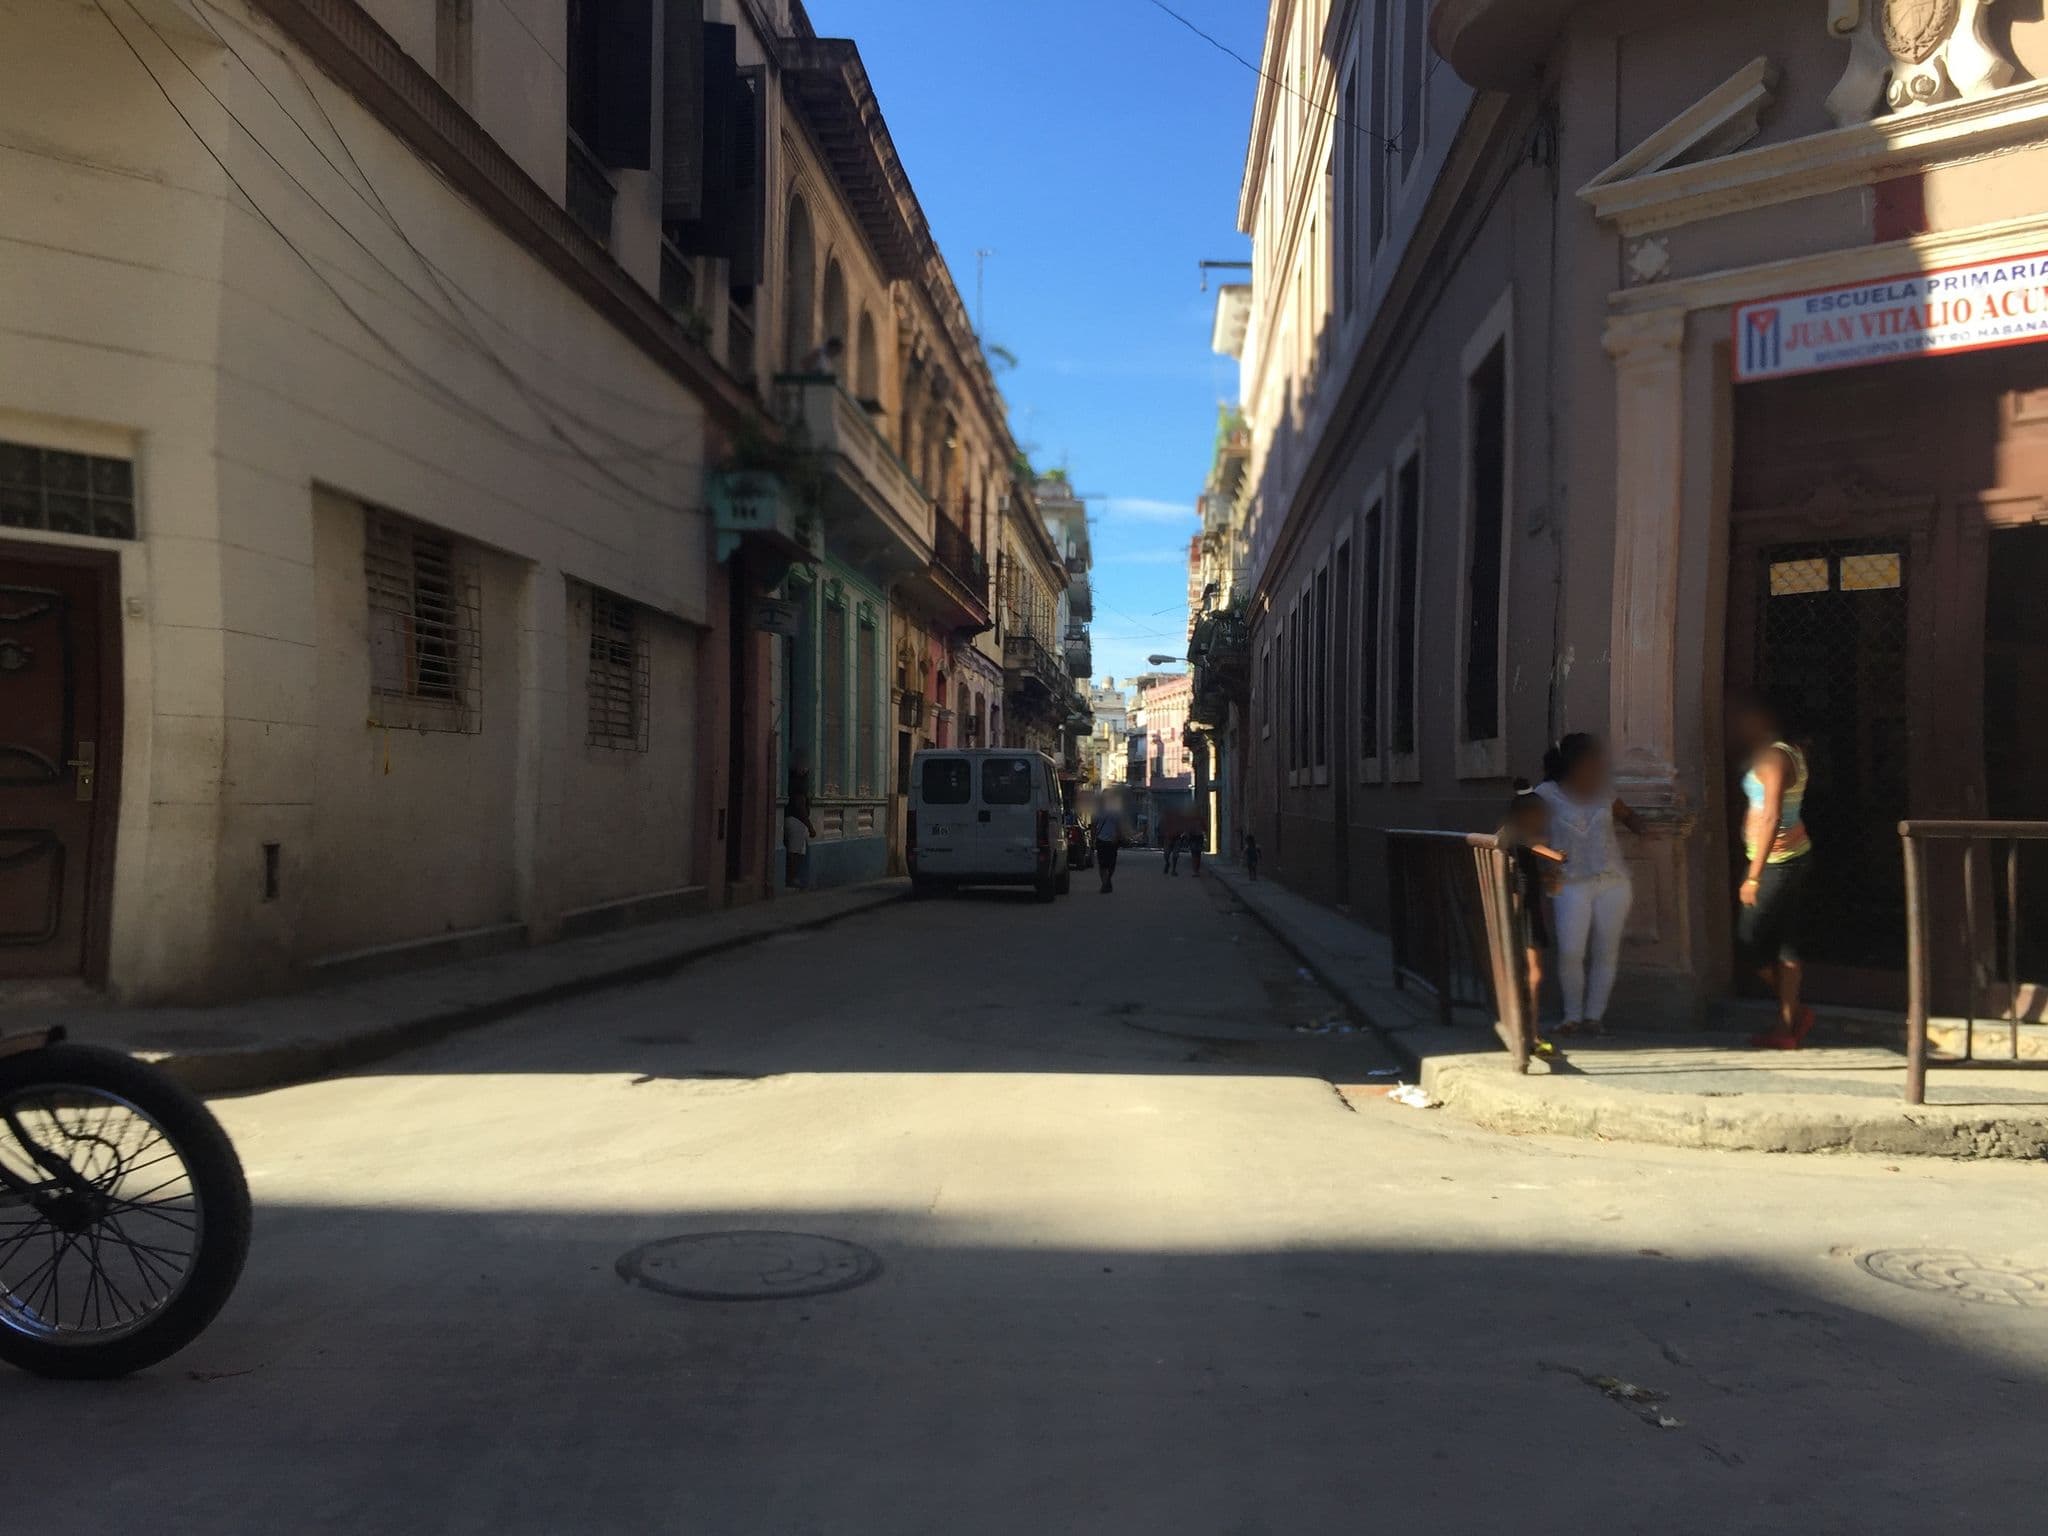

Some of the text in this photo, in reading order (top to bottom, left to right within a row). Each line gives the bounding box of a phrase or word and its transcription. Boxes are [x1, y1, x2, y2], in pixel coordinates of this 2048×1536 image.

[1806, 260, 2048, 312] ESCUELA PRIMARIA
[1785, 285, 2048, 351] JUAN VITALIO ACU
